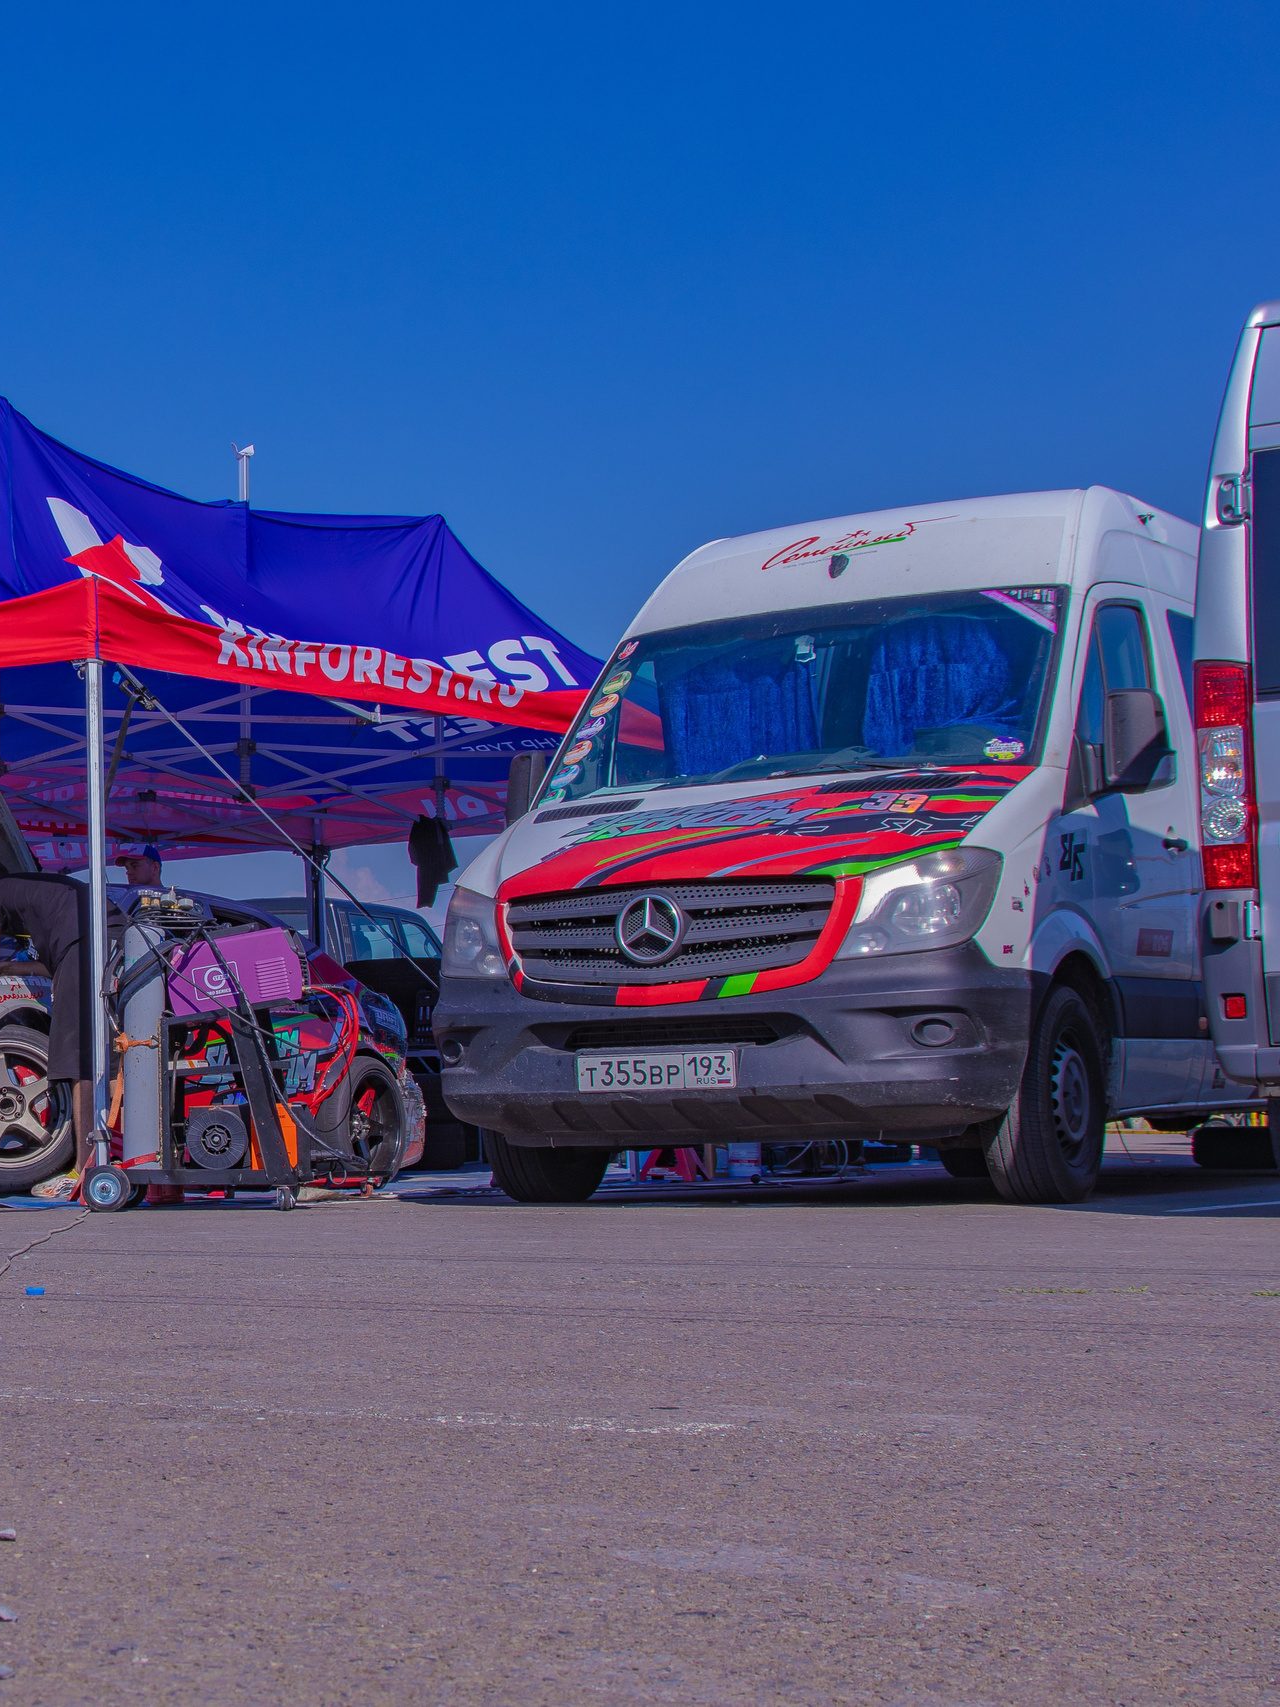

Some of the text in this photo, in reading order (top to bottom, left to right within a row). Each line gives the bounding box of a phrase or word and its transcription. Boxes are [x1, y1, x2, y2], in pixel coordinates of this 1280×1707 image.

[218, 632, 525, 708] KINFOREST.RU
[861, 792, 929, 813] 33
[215, 987, 232, 995] SERIES
[687, 1055, 726, 1077] 193
[696, 1077, 716, 1085] RUS
